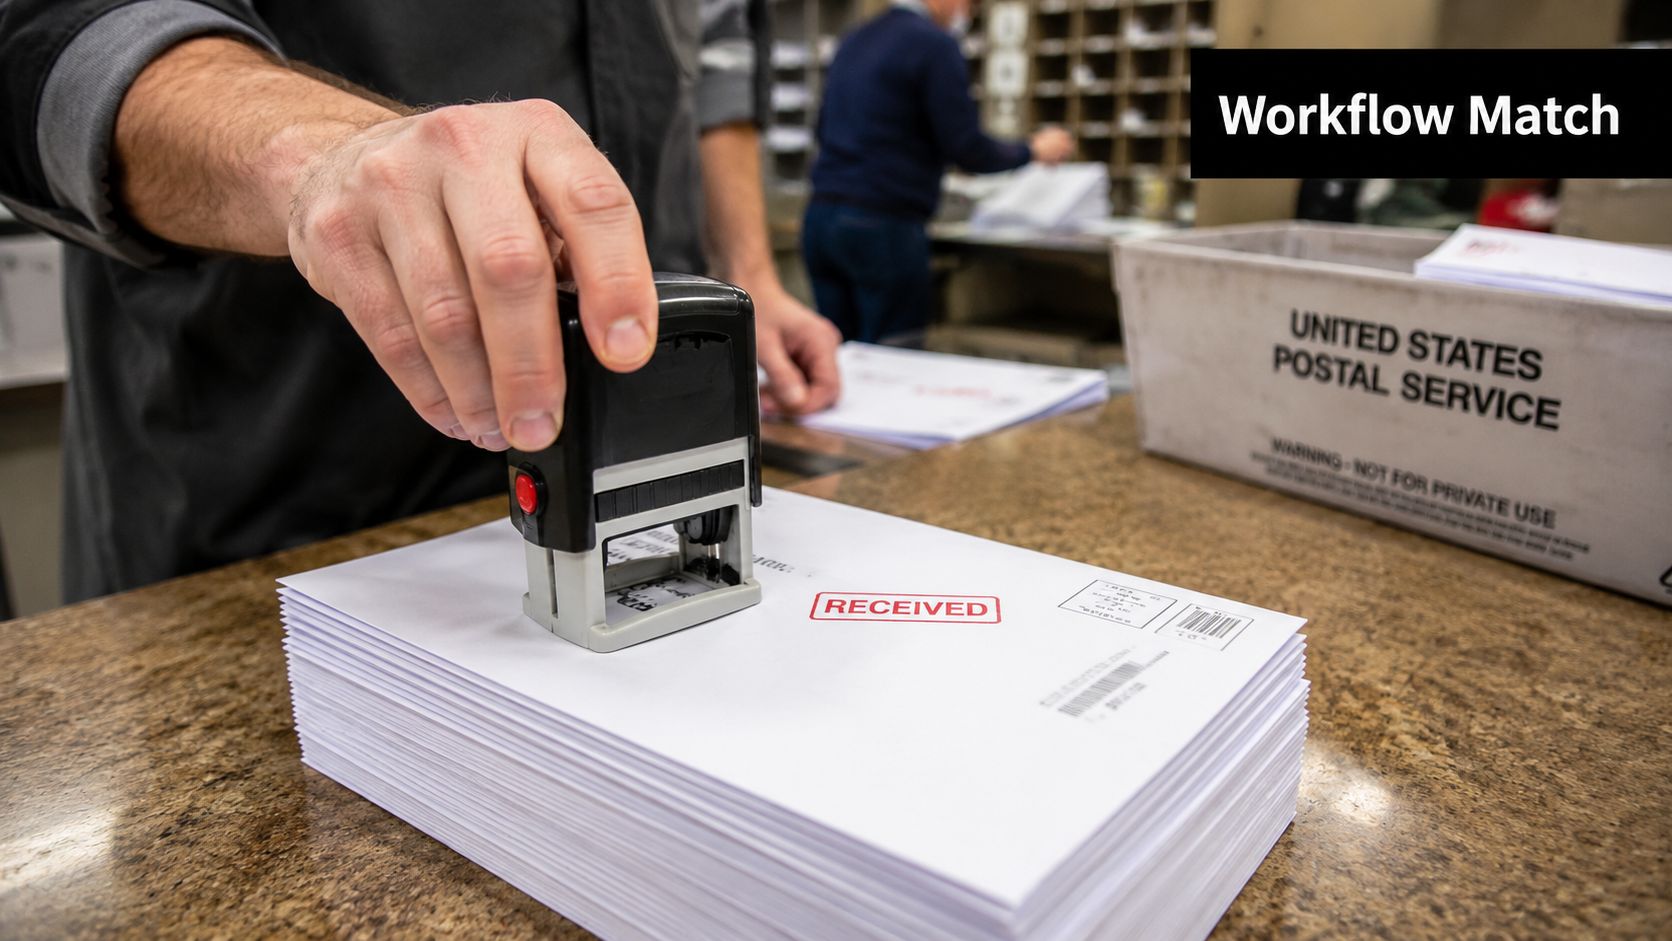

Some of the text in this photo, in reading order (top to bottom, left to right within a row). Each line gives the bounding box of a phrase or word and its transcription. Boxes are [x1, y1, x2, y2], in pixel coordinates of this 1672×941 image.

[1290, 308, 1543, 382] UNITED STATES
[1273, 345, 1561, 430] POSTAL SERVICE
[1271, 438, 1341, 469] WARNING
[1353, 460, 1388, 481] NOT
[1391, 469, 1427, 495] FOR
[1432, 480, 1510, 517] PRIVATE
[1514, 504, 1556, 529] USE
[823, 598, 989, 618] RECEIVED
